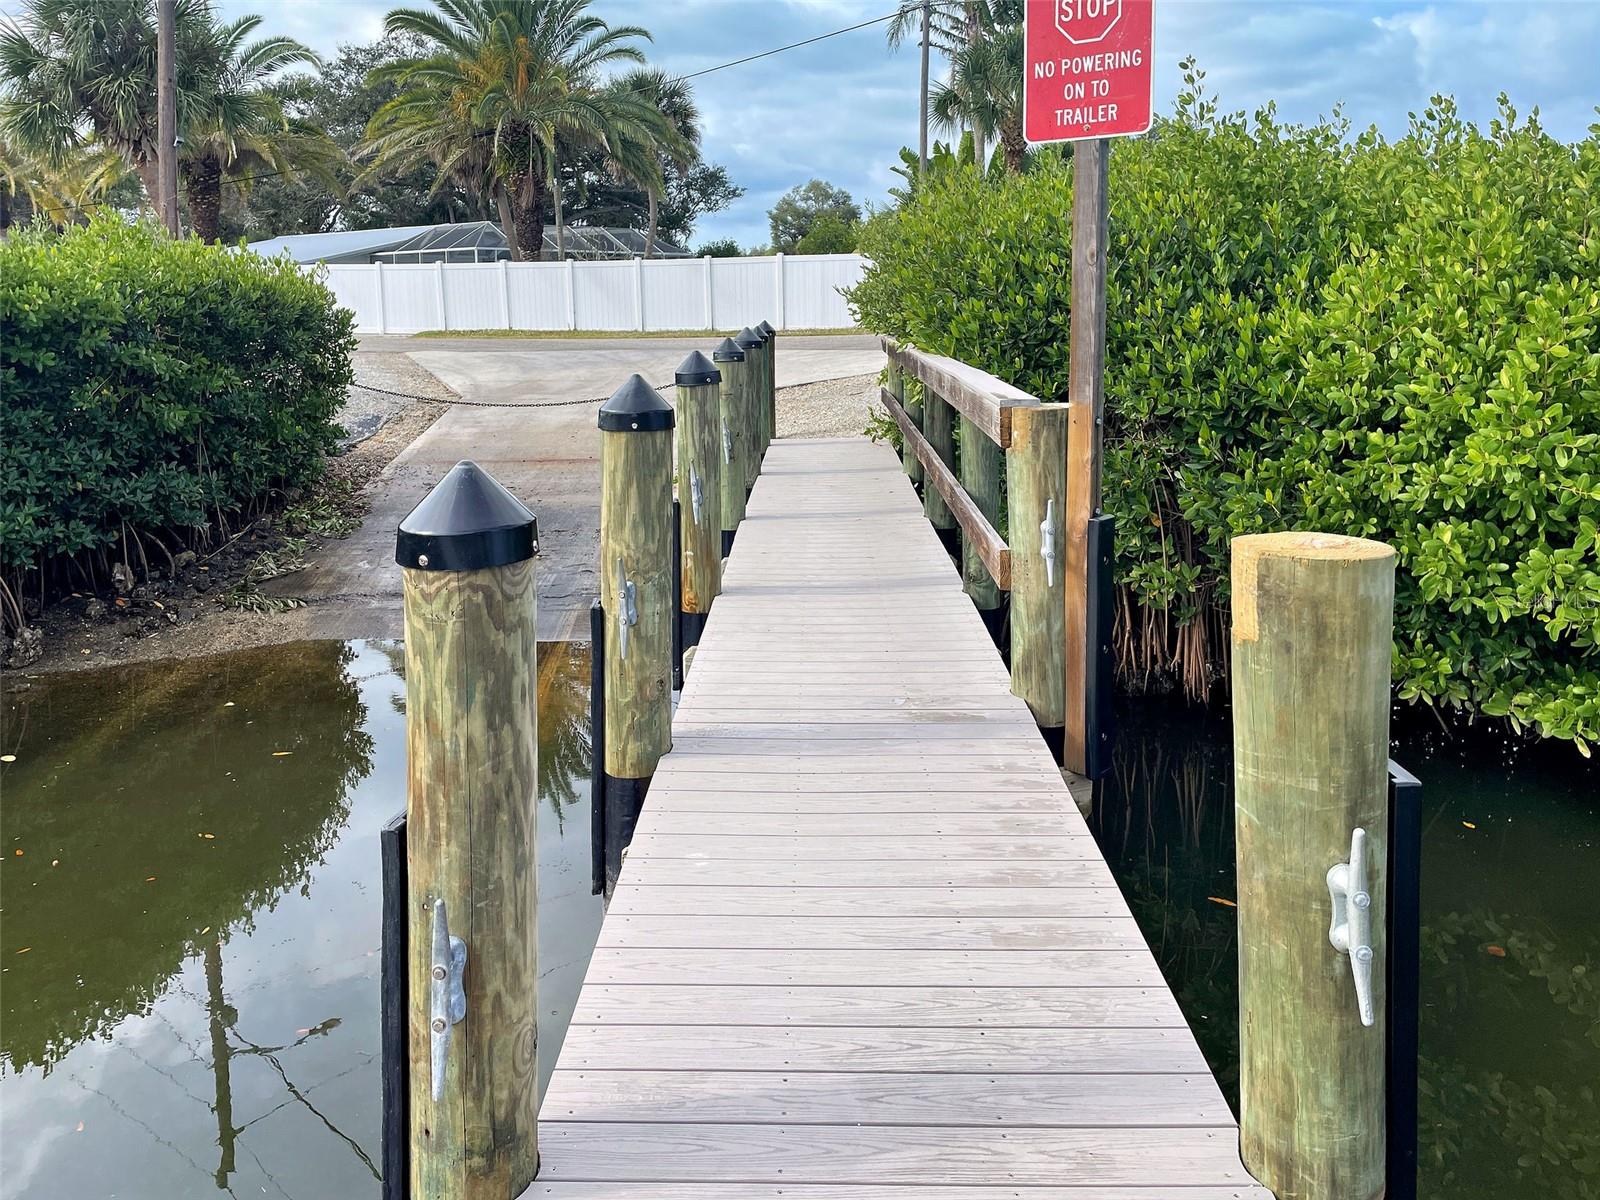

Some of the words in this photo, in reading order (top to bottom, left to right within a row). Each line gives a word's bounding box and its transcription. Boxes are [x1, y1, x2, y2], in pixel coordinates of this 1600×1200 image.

[1060, 0, 1115, 22] STOP
[1034, 60, 1055, 79] NO
[1061, 49, 1142, 76] POWERING
[1063, 82, 1085, 101] ON
[1091, 79, 1110, 98] TO
[1055, 103, 1118, 126] TRAILER
